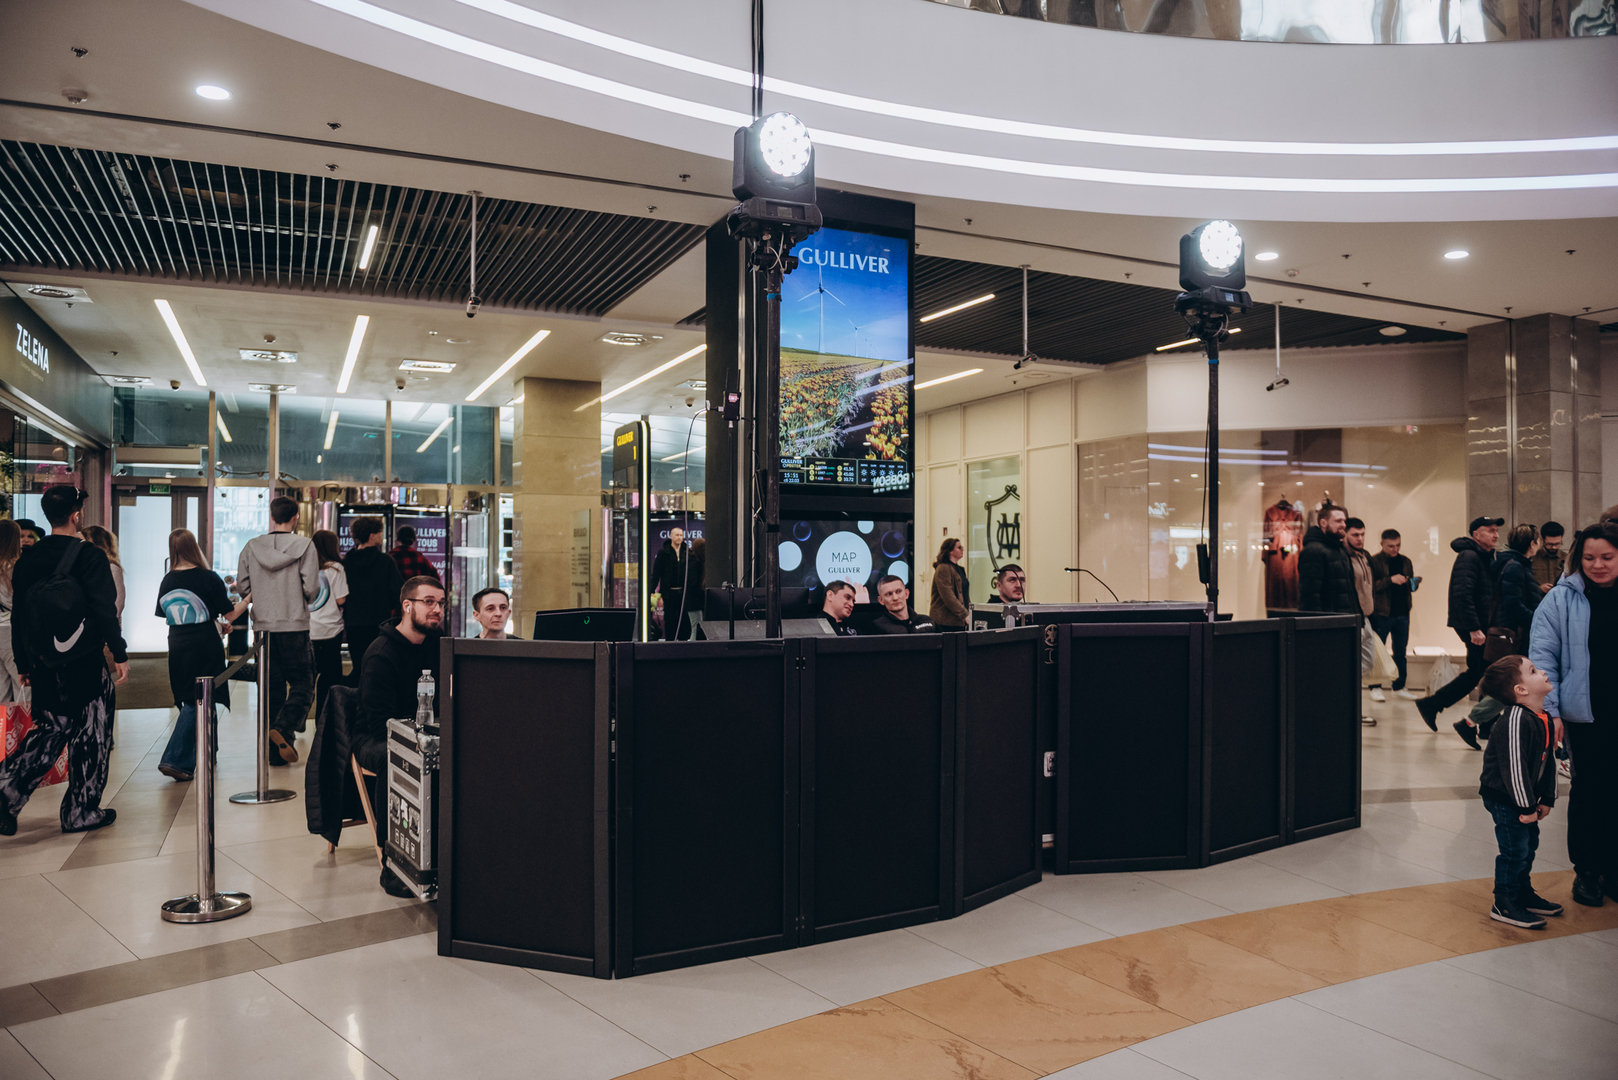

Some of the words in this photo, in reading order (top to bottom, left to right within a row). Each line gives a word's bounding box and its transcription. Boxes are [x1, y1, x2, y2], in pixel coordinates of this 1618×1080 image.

[798, 247, 890, 274] GULLIVER
[16, 323, 49, 374] ZELENA
[633, 445, 637, 460] 1
[417, 538, 438, 548] TOUS
[832, 552, 857, 562] MAP
